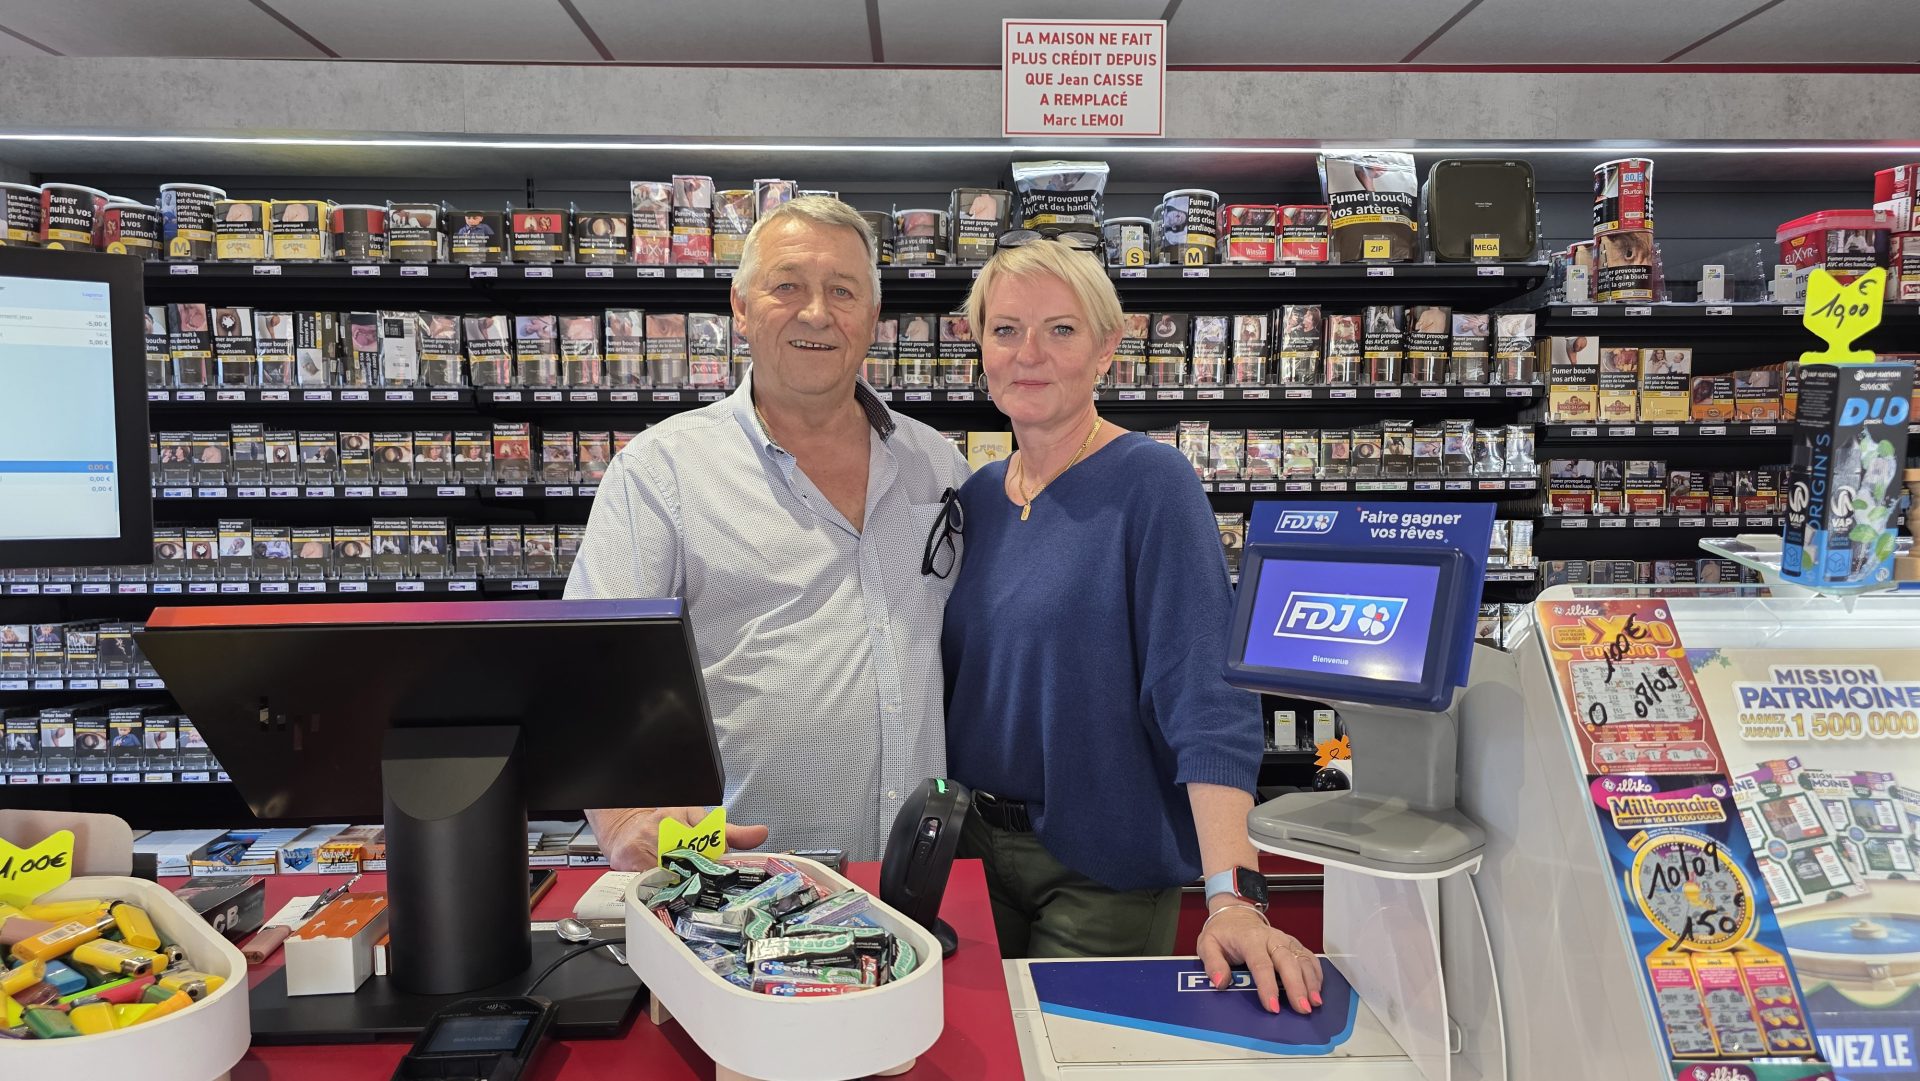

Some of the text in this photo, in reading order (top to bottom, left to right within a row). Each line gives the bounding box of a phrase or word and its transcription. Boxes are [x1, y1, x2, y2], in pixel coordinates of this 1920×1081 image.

[1017, 32, 1152, 45] LA MAISON NE FAIT
[1012, 50, 1157, 66] PLUS CRÉDIT DEPUIS
[1025, 73, 1143, 86] QUE Jean CAISSE
[1040, 92, 1128, 106] A REMPLACÉ
[1043, 114, 1123, 126] Marc LEMOI
[50, 194, 77, 205] Fumer
[1048, 194, 1089, 205] provoque
[1189, 198, 1210, 207] Fumer
[1329, 191, 1413, 208] Fumer bouche
[49, 205, 92, 218] nuit à vos
[1039, 203, 1049, 211] et
[1050, 201, 1065, 212] des
[1330, 203, 1400, 220] vos artères
[120, 210, 146, 220] Fumer
[1188, 208, 1216, 218] provoque
[49, 215, 90, 227] poumons
[1188, 215, 1215, 226] des crises
[1370, 245, 1383, 253] ZIP
[1474, 243, 1498, 251] MEGA
[1130, 252, 1140, 264] S
[1187, 252, 1200, 264] M
[1564, 374, 1586, 383] artères
[1280, 515, 1314, 530] FDJ
[1359, 510, 1462, 528] Faire gagner
[1789, 513, 1806, 523] VAP
[1831, 518, 1853, 527] VAP
[1370, 525, 1444, 540] vos rêves
[1565, 604, 1600, 616] illiko
[1286, 600, 1356, 633] FDJ
[1312, 655, 1349, 666] Bienvenue
[1774, 669, 1878, 685] MISSION
[1739, 686, 1920, 709] PATRIMOINE
[1739, 713, 1787, 725] GAGNEZ
[1792, 711, 1920, 737] 1 500 000
[1616, 779, 1653, 793] illiko
[1612, 797, 1720, 816] Millionnaire
[760, 961, 824, 976] Freedent
[1188, 974, 1251, 988] FJ
[771, 985, 838, 995] Freedent
[1880, 1034, 1913, 1067] LE
